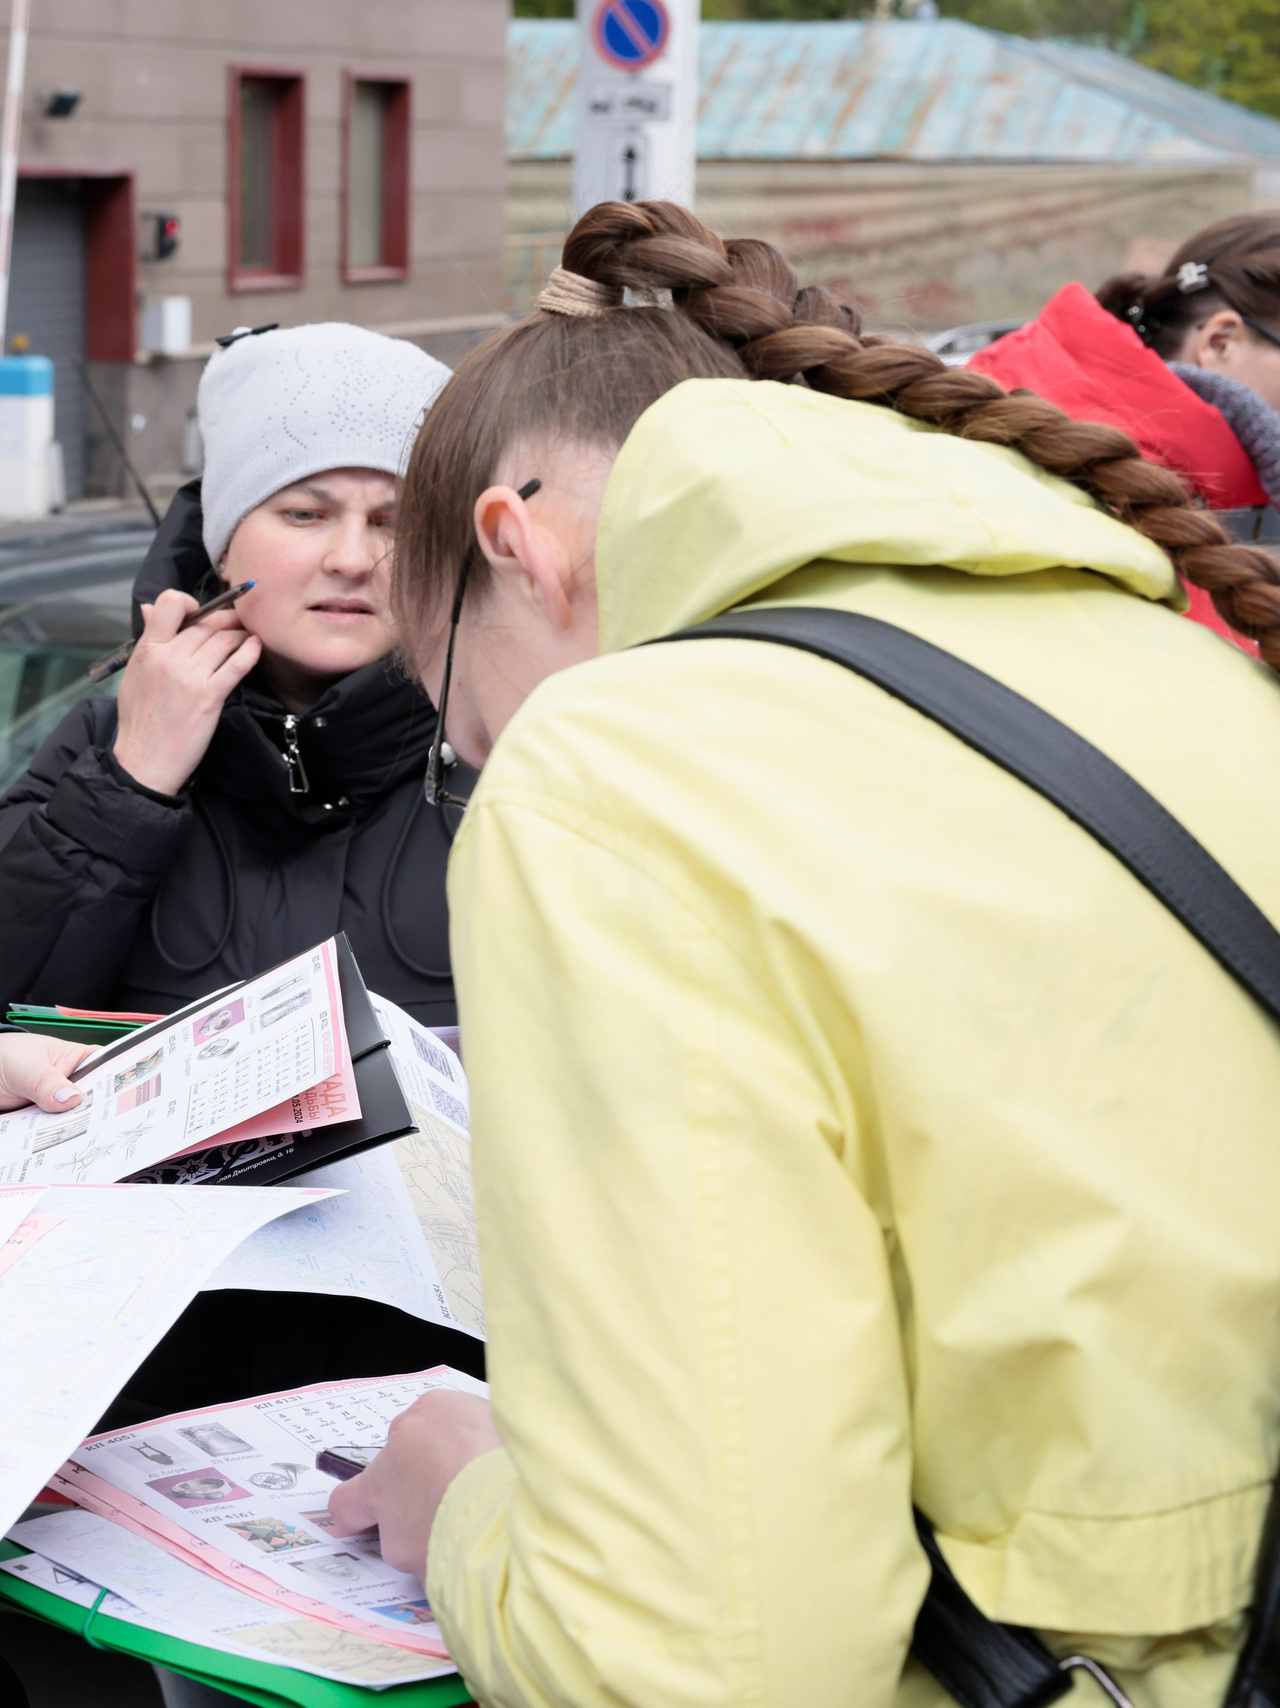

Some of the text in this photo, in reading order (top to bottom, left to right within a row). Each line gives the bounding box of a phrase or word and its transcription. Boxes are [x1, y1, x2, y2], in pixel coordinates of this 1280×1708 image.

[232, 1155, 277, 1178] Дмитровка,
[254, 1395, 305, 1410] КП 4131
[84, 1432, 139, 1452] КП 4051
[224, 1452, 265, 1463] Колокол
[161, 1466, 188, 1477] Лира
[203, 1503, 236, 1516] Бубен
[202, 1510, 256, 1524] КП 4161
